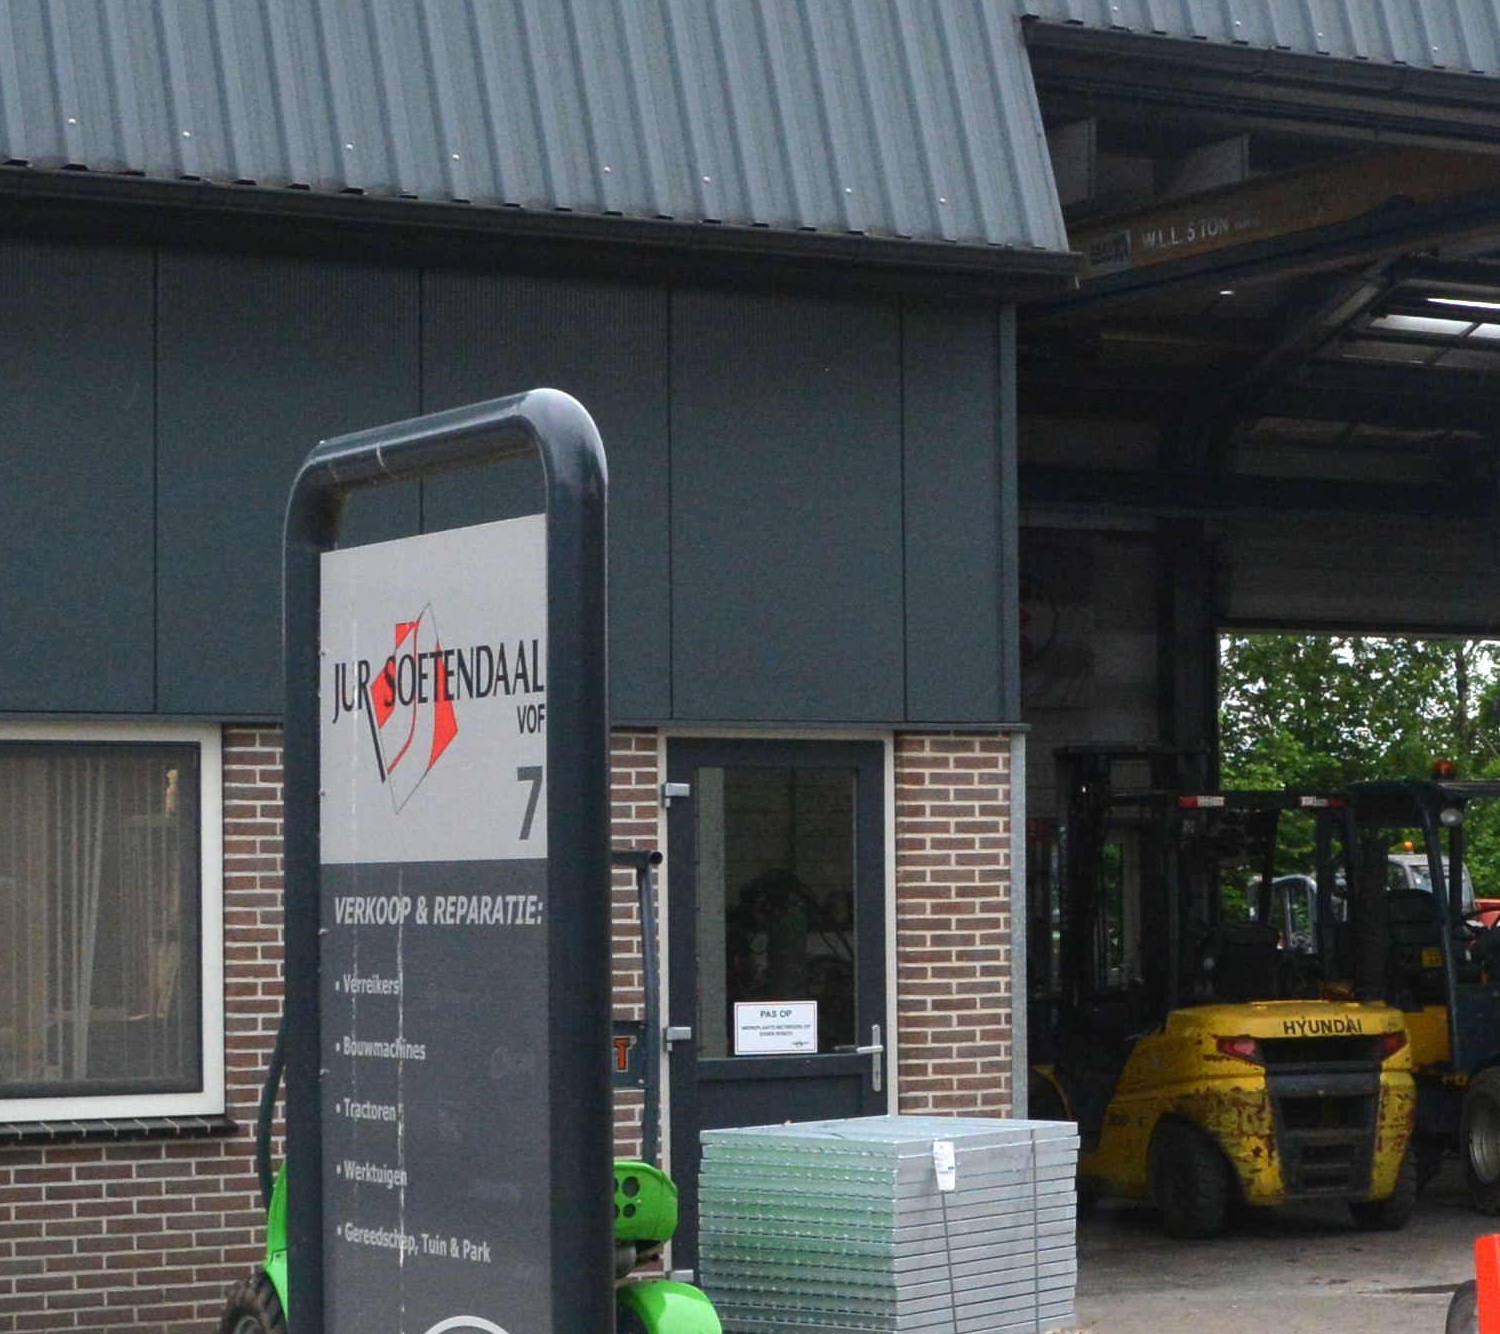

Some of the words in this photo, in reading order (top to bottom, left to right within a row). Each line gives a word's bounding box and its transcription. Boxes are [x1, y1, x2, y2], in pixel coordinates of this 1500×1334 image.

[1187, 222, 1195, 241] 5
[1201, 218, 1228, 239] TON
[384, 639, 545, 707] SOETENDAAL
[517, 703, 546, 734] VOF
[517, 765, 543, 841] 7
[335, 896, 412, 925] VERKOOP
[416, 896, 428, 925] &
[433, 895, 544, 925] REPARATIE:
[343, 974, 400, 995] Verreikers
[760, 1010, 777, 1018] PAS
[779, 1010, 792, 1018] OP
[1283, 1018, 1362, 1035] HYUNDAI
[343, 1036, 426, 1060] Bouwmachines
[343, 1098, 396, 1121] Tractoren
[344, 1160, 408, 1189] Werktuigen
[344, 1222, 419, 1257] Gereedschap,
[421, 1233, 447, 1256] Tuin
[450, 1237, 460, 1257] &
[463, 1238, 491, 1263] Park
